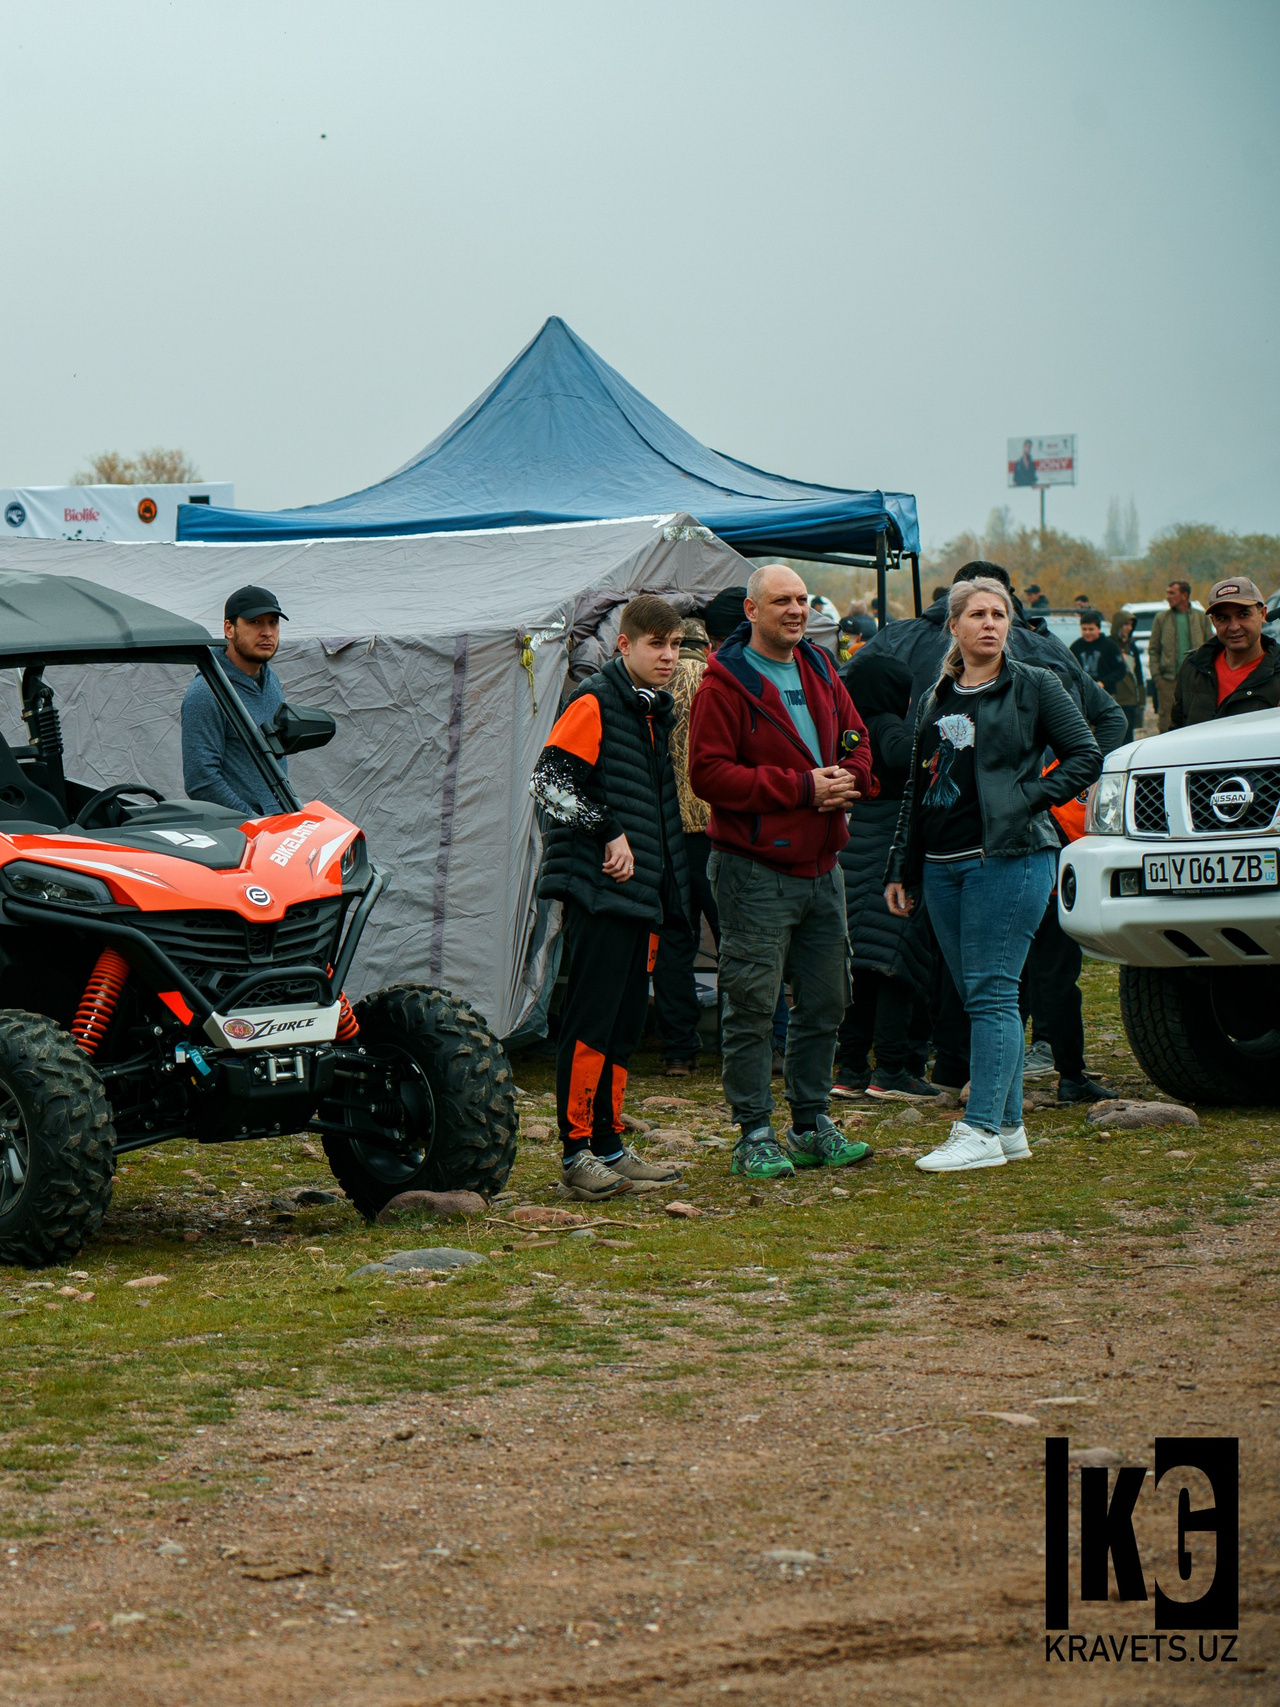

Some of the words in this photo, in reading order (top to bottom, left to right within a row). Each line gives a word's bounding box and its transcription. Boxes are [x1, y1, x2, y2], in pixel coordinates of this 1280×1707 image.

[64, 508, 100, 522] Biolife
[1211, 794, 1247, 803] NISSAN
[269, 820, 320, 867] BIKELAND
[1265, 872, 1276, 882] UZ
